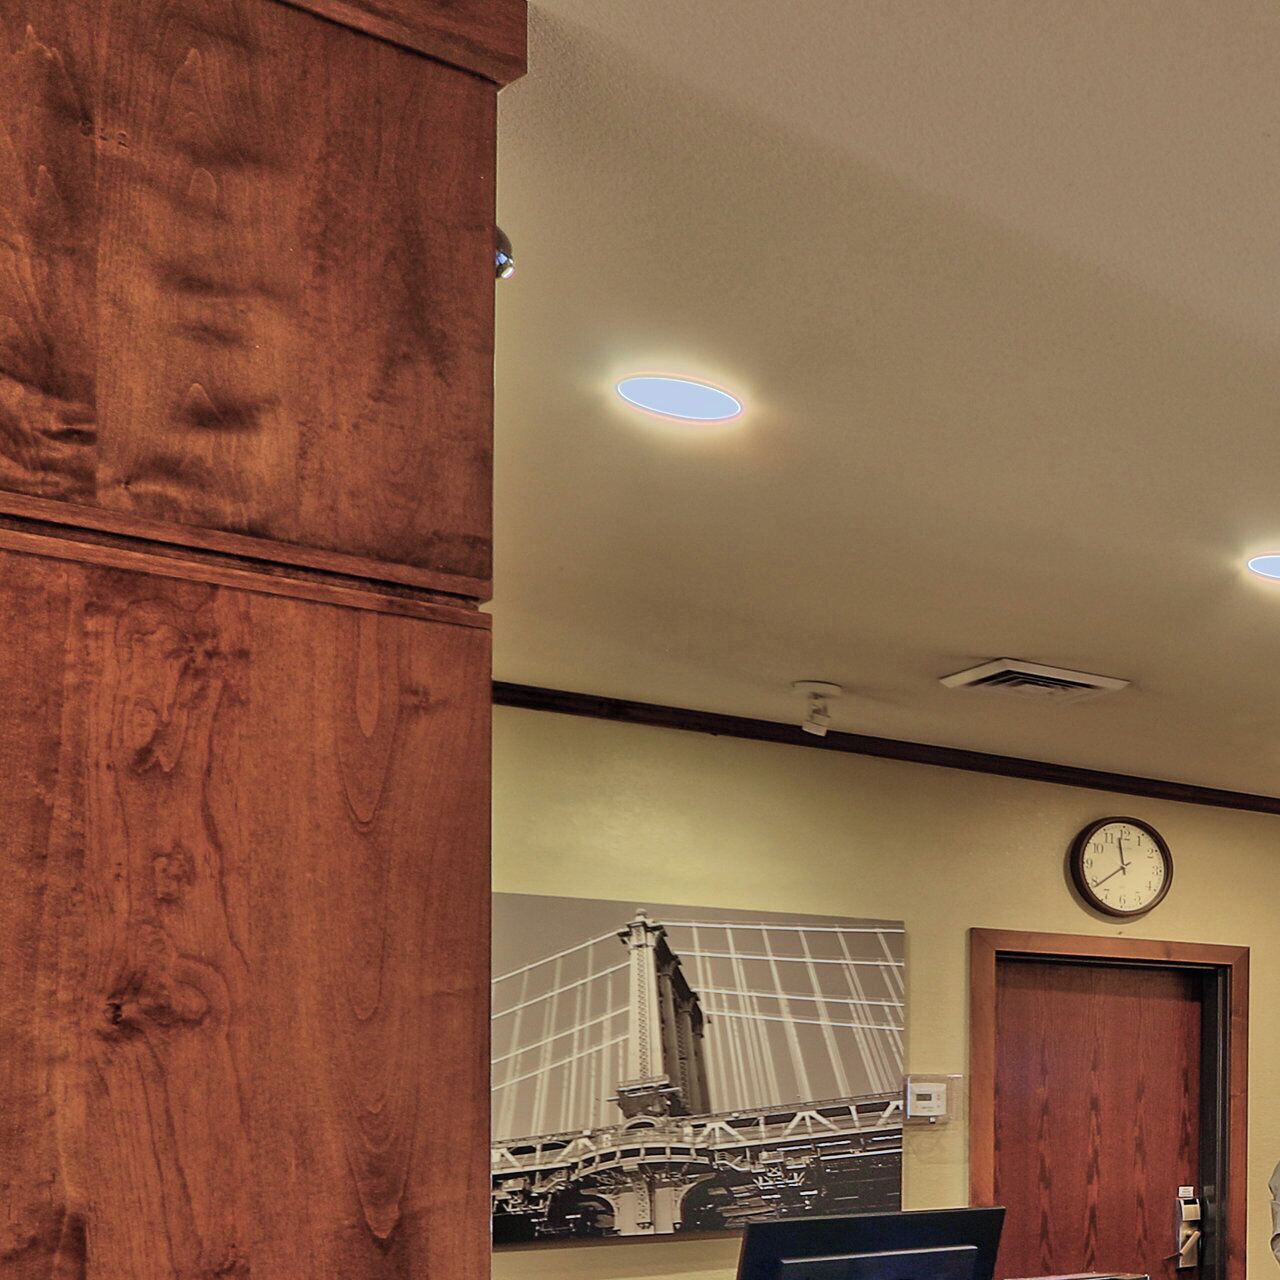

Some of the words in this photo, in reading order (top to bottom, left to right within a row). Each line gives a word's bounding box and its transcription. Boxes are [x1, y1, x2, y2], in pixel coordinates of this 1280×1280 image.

[1104, 832, 1114, 844] 11
[1120, 830, 1131, 841] 12
[1137, 835, 1141, 847] 1
[1093, 843, 1104, 854] 10
[1147, 848, 1154, 859] 2
[1085, 858, 1093, 869] 9
[1152, 865, 1159, 876] 3
[1091, 876, 1099, 887] 8
[1145, 880, 1152, 891] 4
[1103, 888, 1110, 900] 7
[1119, 894, 1126, 905] 6
